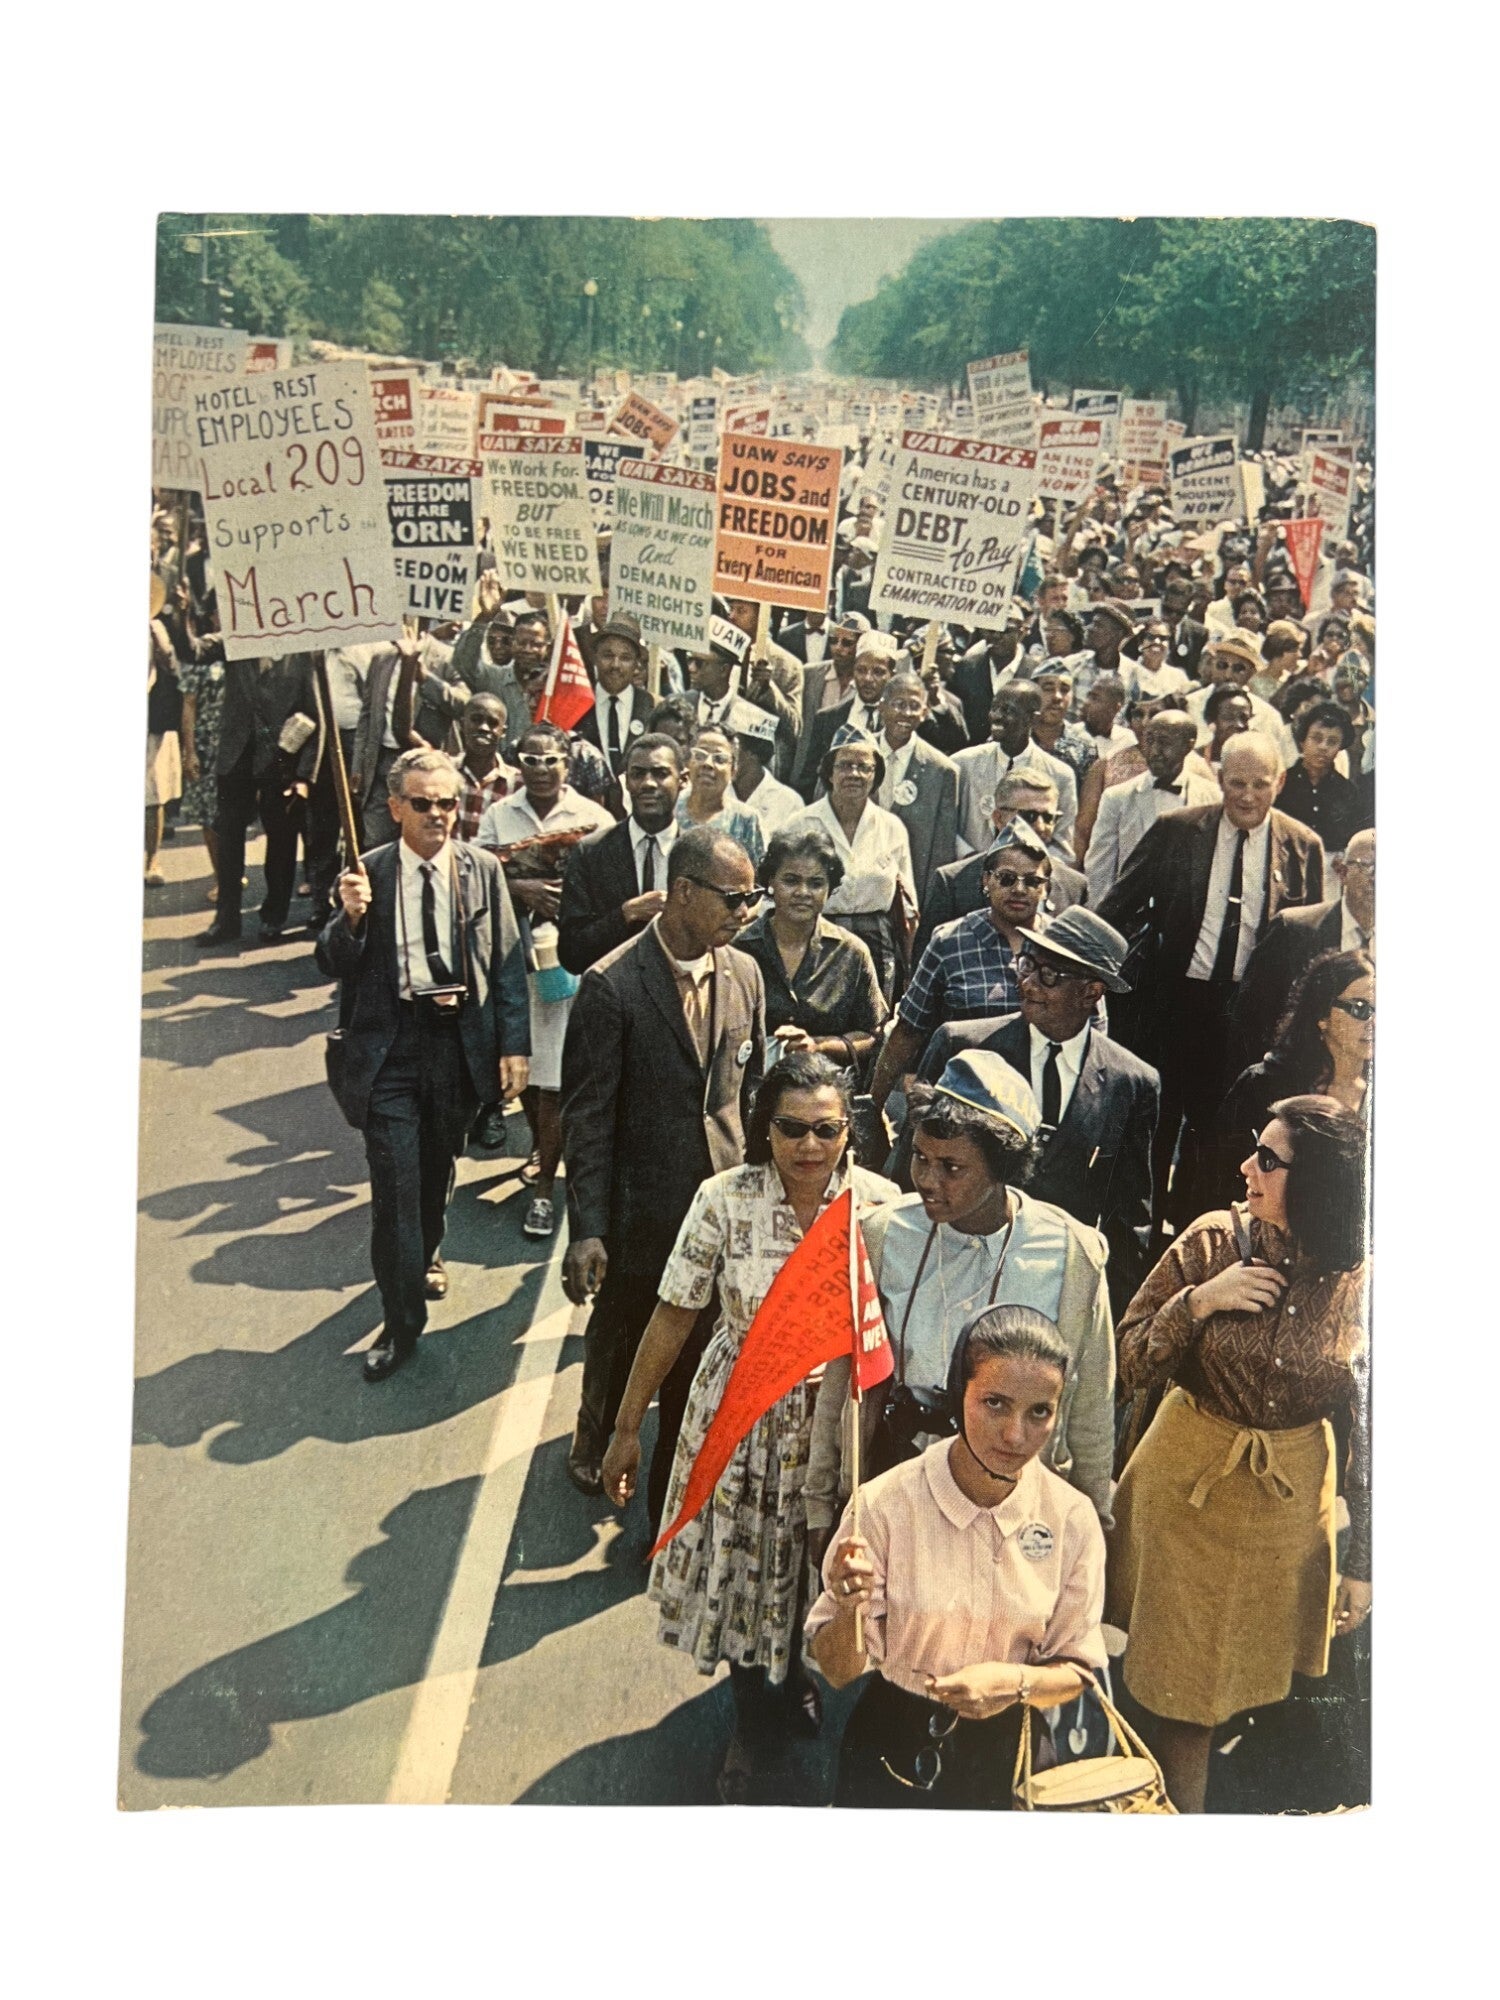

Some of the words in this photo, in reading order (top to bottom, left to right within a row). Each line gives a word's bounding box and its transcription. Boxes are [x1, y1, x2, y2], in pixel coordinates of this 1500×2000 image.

[154, 347, 236, 373] MPLOYEES
[195, 387, 256, 412] HOTEL
[273, 374, 316, 400] REST
[197, 399, 353, 447] EMPLOYEES
[616, 411, 652, 440] JOBS
[482, 437, 520, 451] UAW
[732, 443, 778, 463] UAW
[782, 452, 831, 471] SAYS
[905, 433, 960, 455] UAW
[960, 440, 1037, 468] SAYS:
[200, 458, 276, 501] Local
[286, 436, 364, 490] 209
[487, 460, 506, 475] We
[509, 460, 548, 477] Work
[621, 460, 659, 480] UAW
[906, 457, 969, 487] America
[972, 469, 997, 493] has
[1001, 480, 1011, 493] a
[1042, 464, 1058, 475] TO
[1062, 467, 1090, 480] BIAS
[1182, 475, 1231, 488] DECENT
[723, 467, 797, 502] JOBS
[798, 488, 831, 508] and
[901, 482, 1022, 517] CENTURY-OLD
[391, 504, 415, 518] WE
[418, 504, 450, 518] ARE
[516, 503, 560, 522] BUT
[617, 487, 638, 518] We
[640, 491, 664, 521] Will
[667, 497, 714, 531] March
[1183, 499, 1234, 515] NOW!
[215, 504, 350, 553] Supports
[393, 520, 469, 543] ORN-
[504, 525, 520, 536] TO
[525, 527, 541, 538] BE
[547, 529, 581, 540] FREE
[671, 532, 687, 545] WE
[720, 503, 829, 545] FREEDOM
[895, 507, 969, 547] DEBT
[502, 541, 528, 558] WE
[534, 543, 588, 561] NEED
[637, 544, 677, 567] And
[755, 545, 787, 559] FOR
[949, 537, 976, 573] to
[979, 536, 1019, 573] Pay
[504, 562, 526, 578] TO
[532, 564, 592, 584] WORK
[620, 564, 697, 594] DEMAND
[716, 551, 753, 584] Every
[755, 559, 822, 588] American
[887, 566, 978, 593] CONTRACTED
[982, 582, 1007, 599] ON
[224, 557, 378, 631] March
[409, 584, 463, 613] LIVE
[616, 586, 643, 605] THE
[647, 593, 704, 618] RIGHTS
[880, 584, 977, 612] EMANCIPATION
[980, 600, 1004, 618] DAY
[711, 623, 748, 649] UAW
